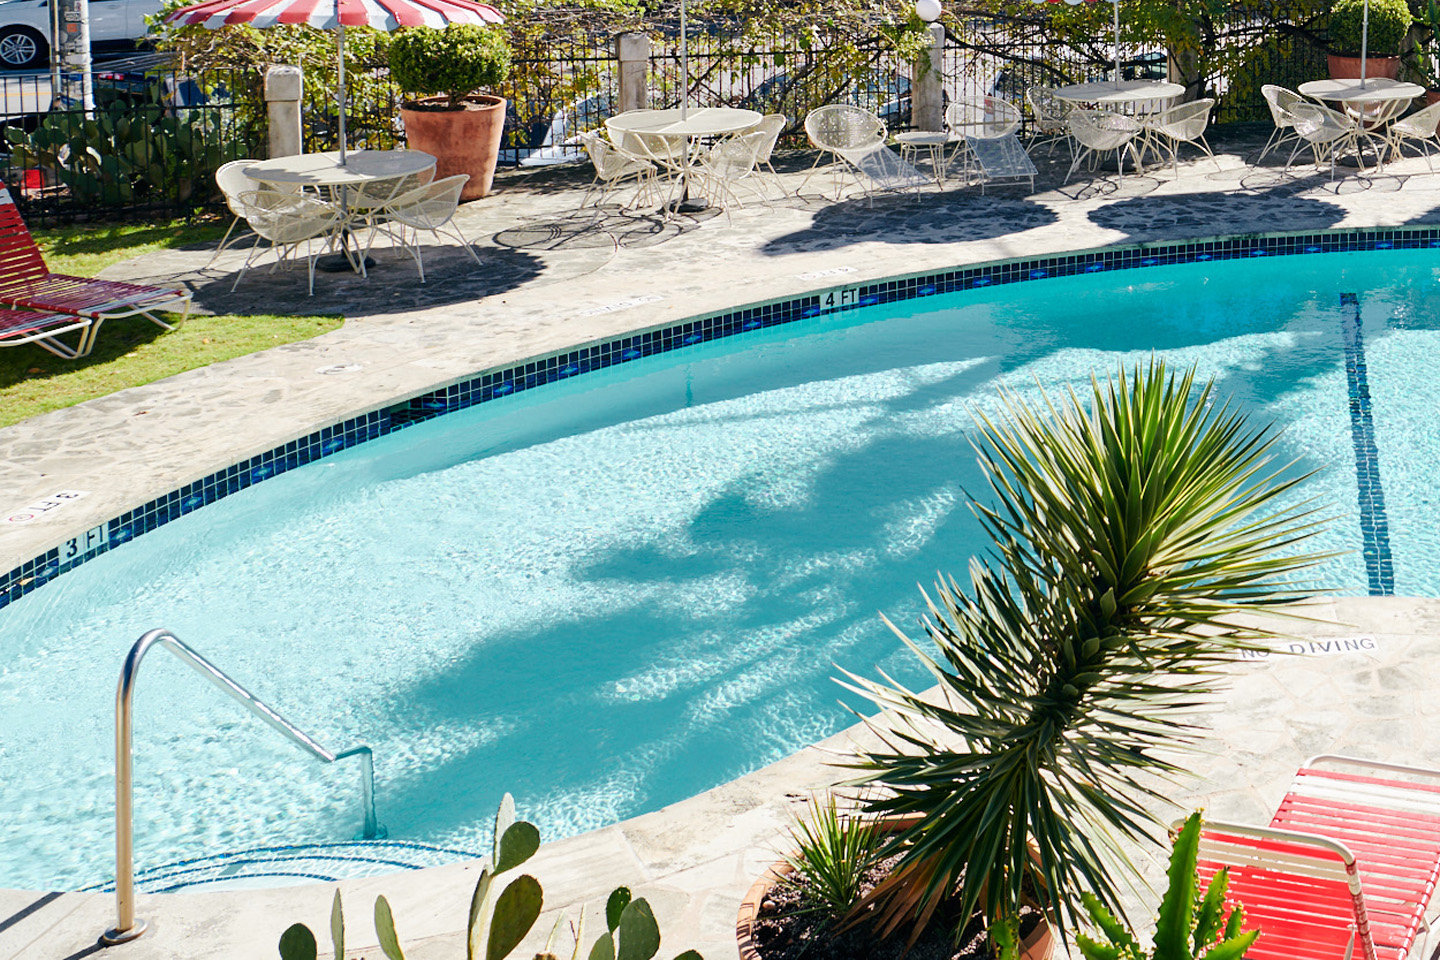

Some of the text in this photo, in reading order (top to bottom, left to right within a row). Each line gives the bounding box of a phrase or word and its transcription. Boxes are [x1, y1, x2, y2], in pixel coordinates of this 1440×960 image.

[826, 288, 857, 307] 4 FT
[66, 537, 77, 558] 3
[1289, 638, 1375, 654] DIVING
